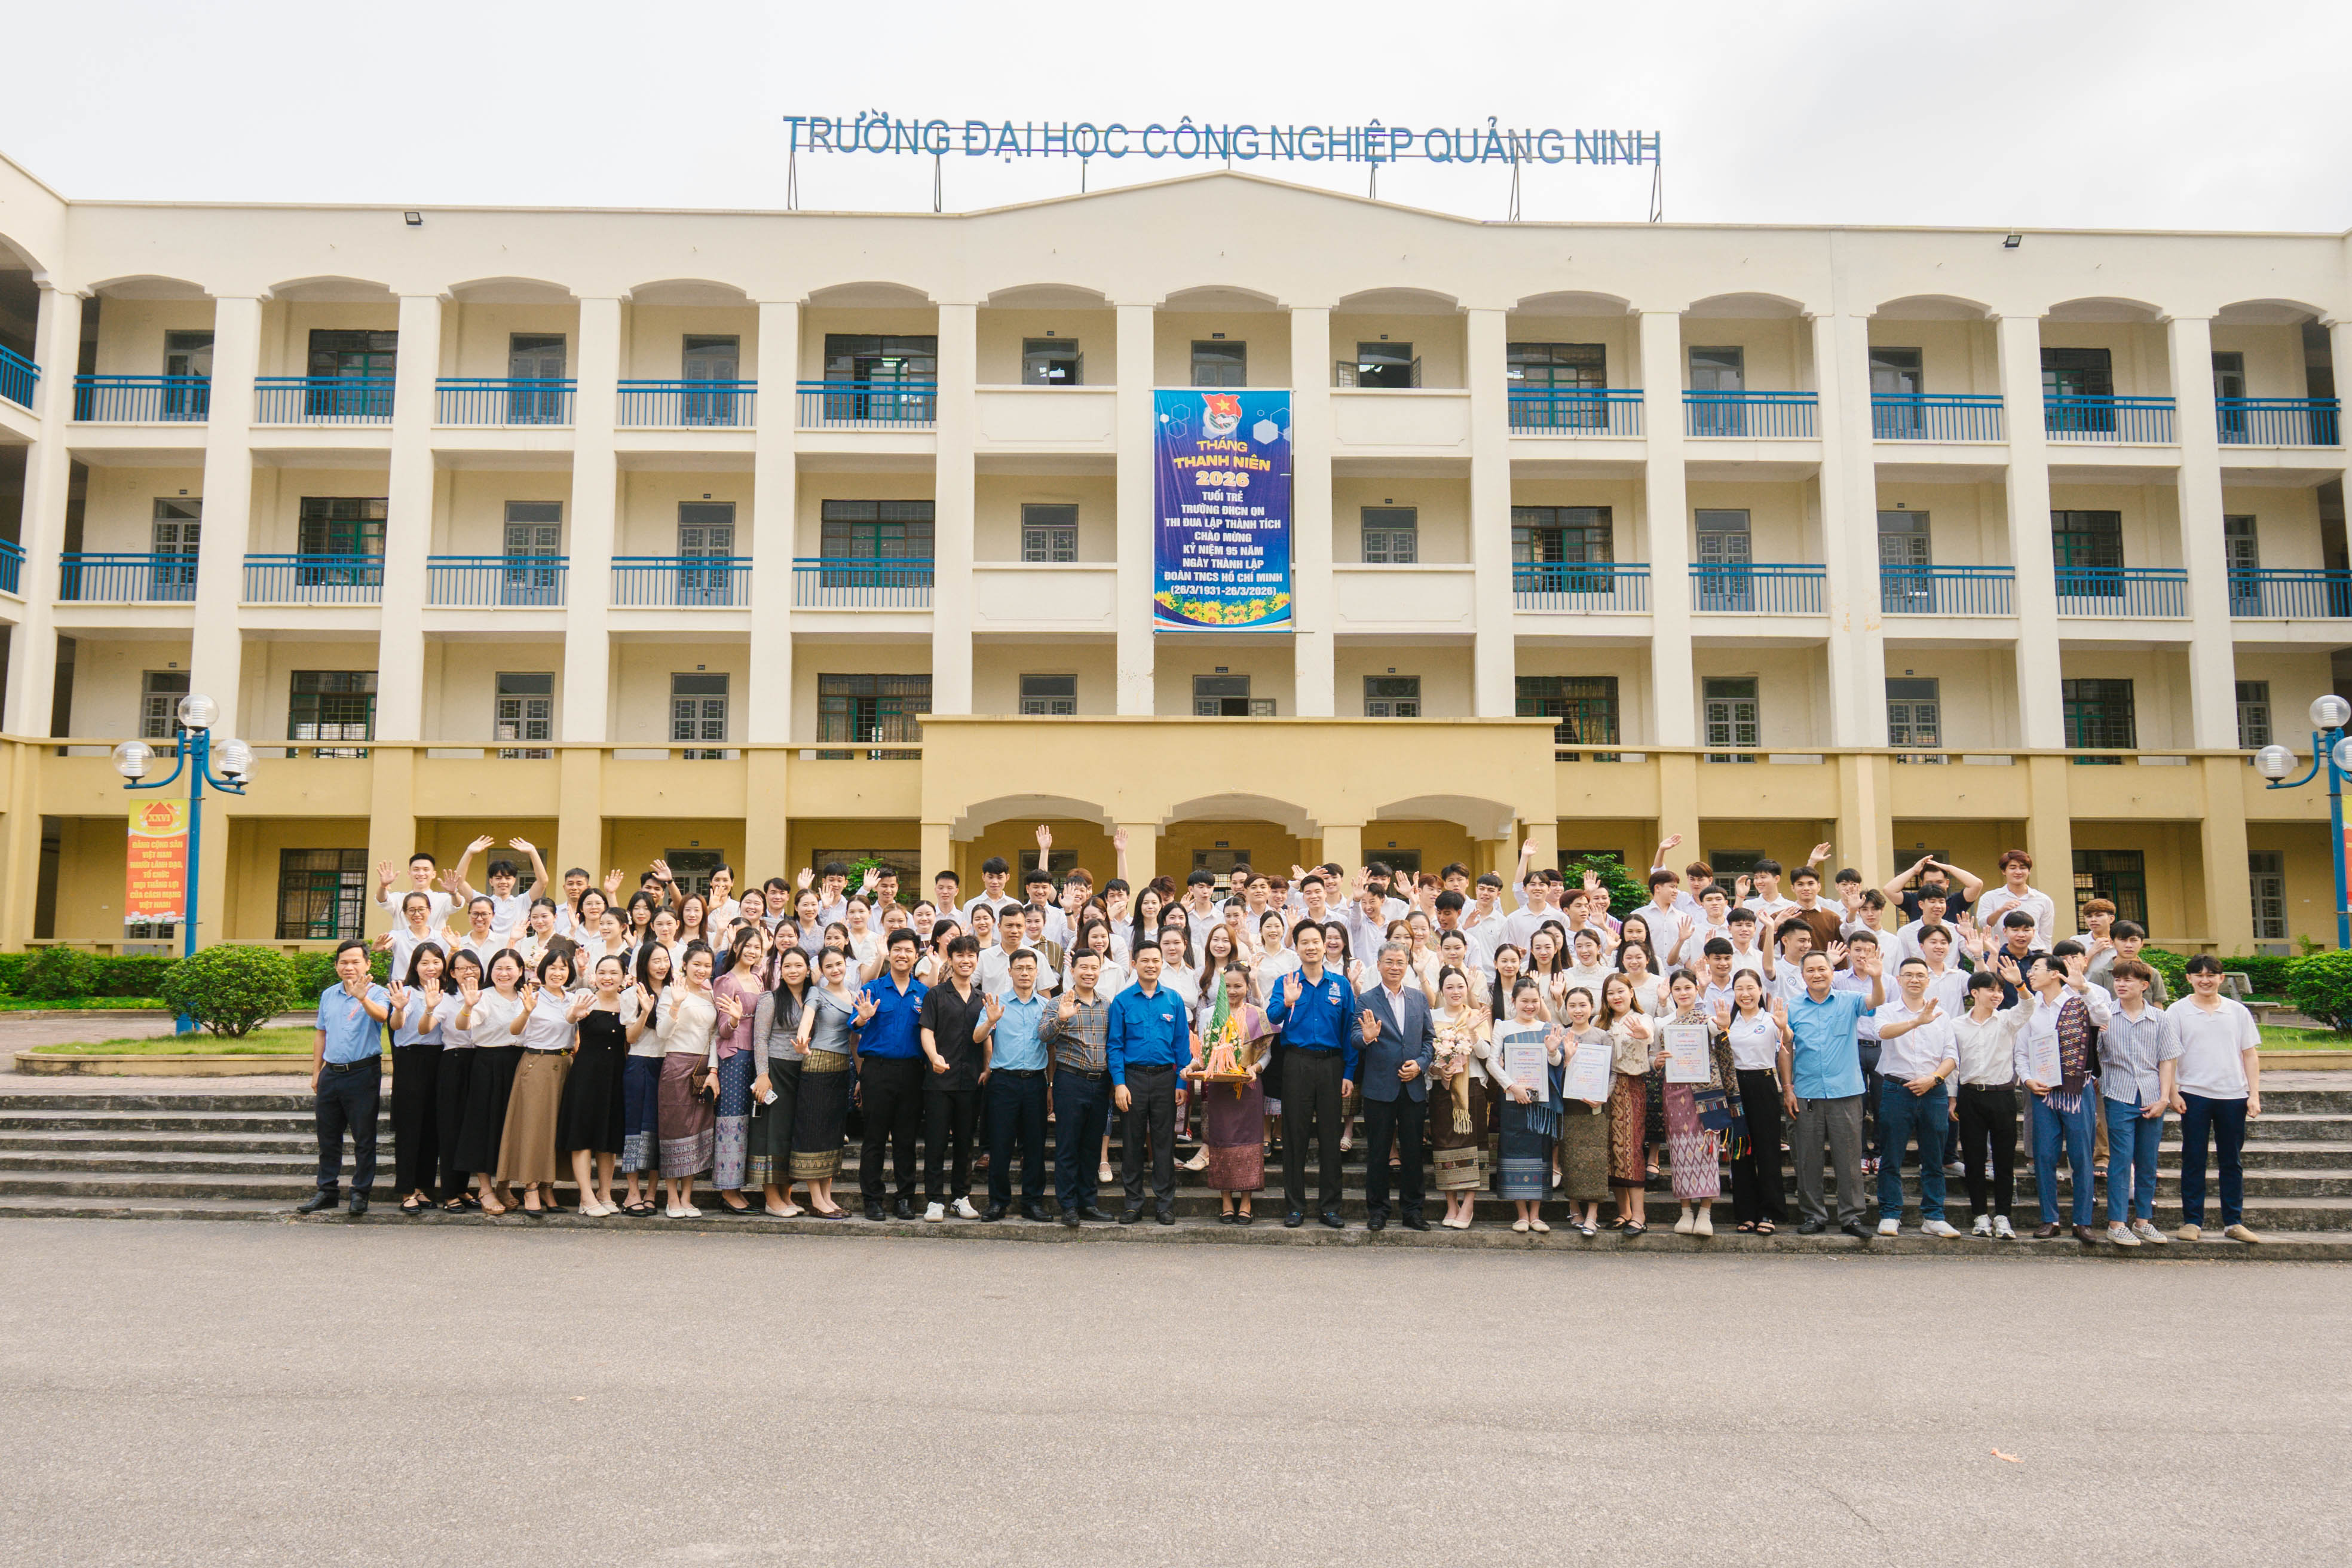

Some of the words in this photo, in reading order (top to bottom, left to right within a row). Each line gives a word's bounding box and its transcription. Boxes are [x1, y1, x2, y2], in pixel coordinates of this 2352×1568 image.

[783, 108, 950, 155] TRƯỜNG
[962, 120, 1032, 163] ĐẠI
[1043, 121, 1129, 164] HỌC
[1143, 116, 1259, 161] CÔNG
[1271, 119, 1414, 169] NGHIỆP
[1425, 116, 1565, 164] QUẢNG
[1575, 129, 1660, 165] NINH
[1196, 436, 1248, 452] THÁNG
[1173, 455, 1229, 468] THANH
[1233, 454, 1271, 471] NIÊN
[1195, 470, 1250, 487] 2026
[1202, 489, 1224, 501] TUỔI
[1226, 491, 1244, 502] TRẺ
[1181, 503, 1220, 514] TRƯỜNG
[1221, 506, 1248, 516] ĐHCN
[1251, 507, 1265, 516] QN
[1165, 517, 1180, 527] THI
[1183, 517, 1202, 527] ĐUA
[1204, 517, 1223, 529] LẬP
[1225, 518, 1257, 529] THÀNH
[1259, 518, 1281, 529] TÍCH
[1195, 530, 1220, 541] CHÀO
[1223, 531, 1252, 542] MỪNG
[1183, 542, 1196, 554] KỶ
[1198, 544, 1224, 556] NIỆM
[1226, 546, 1238, 555] 95
[1240, 545, 1264, 555] NĂM
[1183, 557, 1208, 567] NGÀY
[1211, 557, 1243, 569] THÀNH
[1245, 558, 1264, 571] LẬP
[1164, 570, 1192, 581] ĐOÀN
[1194, 572, 1219, 581] TNCS
[1237, 571, 1254, 582] CHÍ
[1256, 573, 1283, 582] MINH
[1171, 585, 1277, 596] (26/3/1931-26/3/2026)
